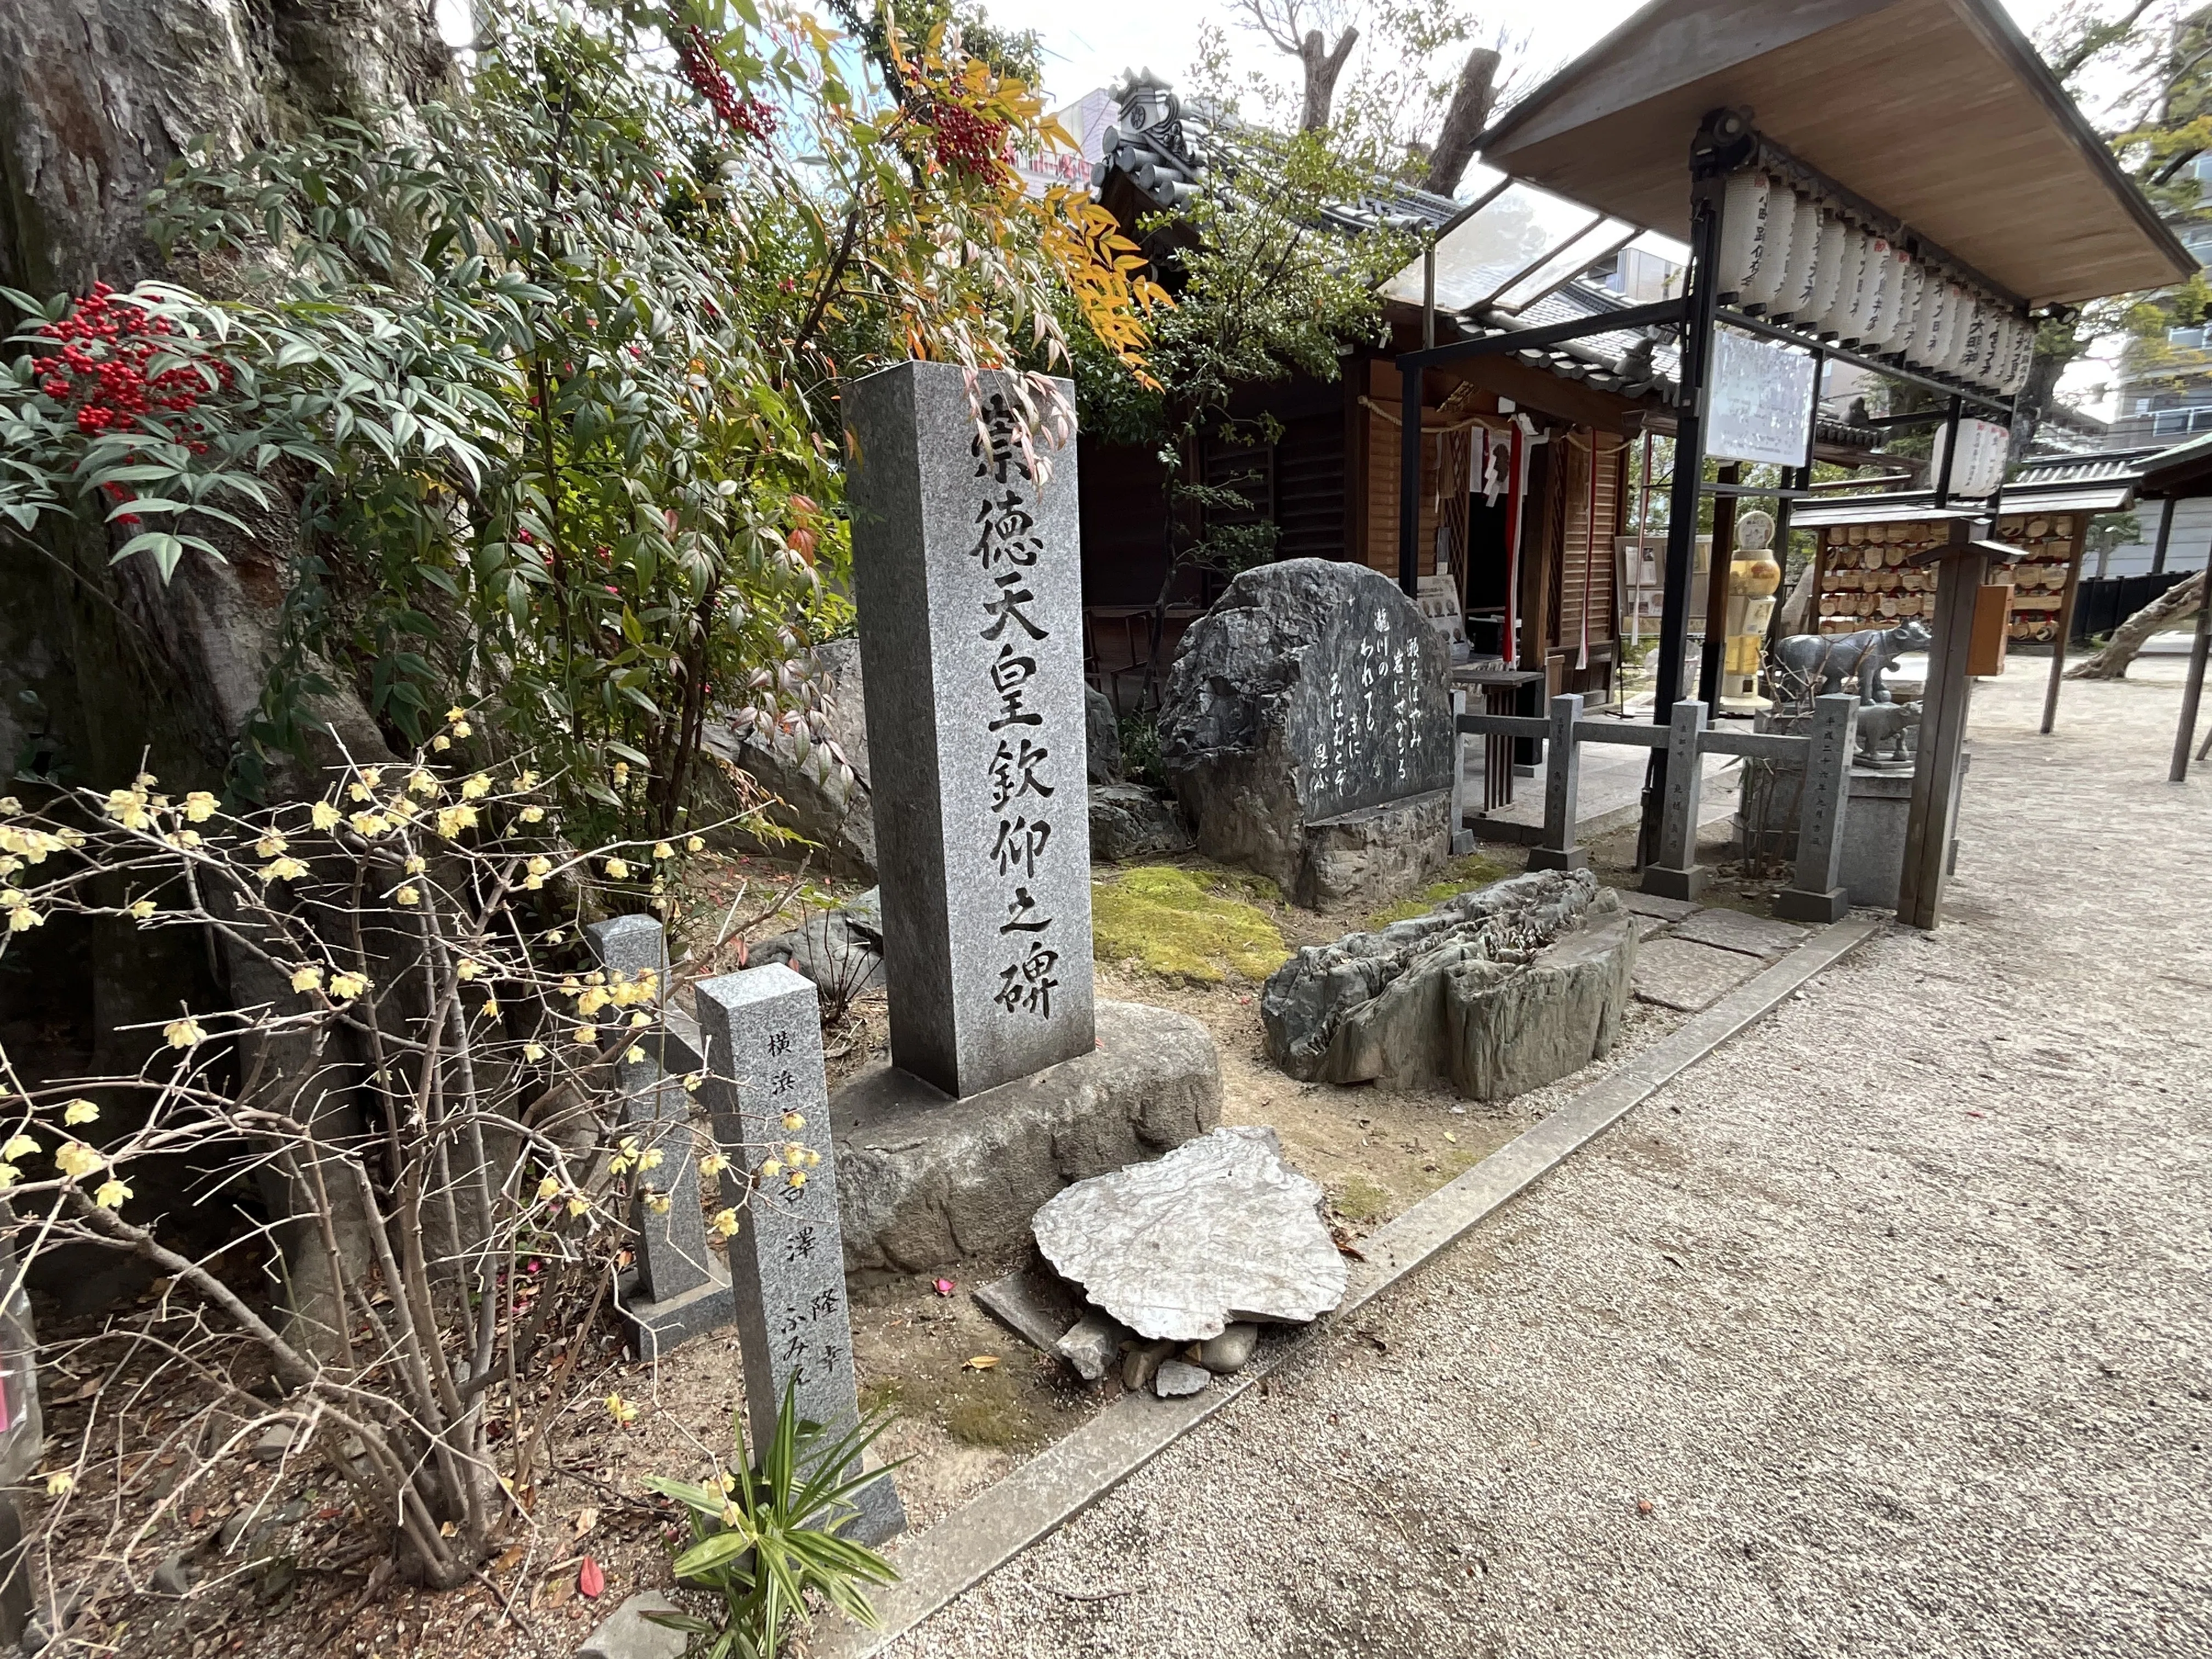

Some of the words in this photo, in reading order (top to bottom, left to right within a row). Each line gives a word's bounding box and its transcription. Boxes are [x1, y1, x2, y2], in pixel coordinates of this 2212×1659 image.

[969, 393, 1059, 1021] 崇徳天皇欽仰之碑
